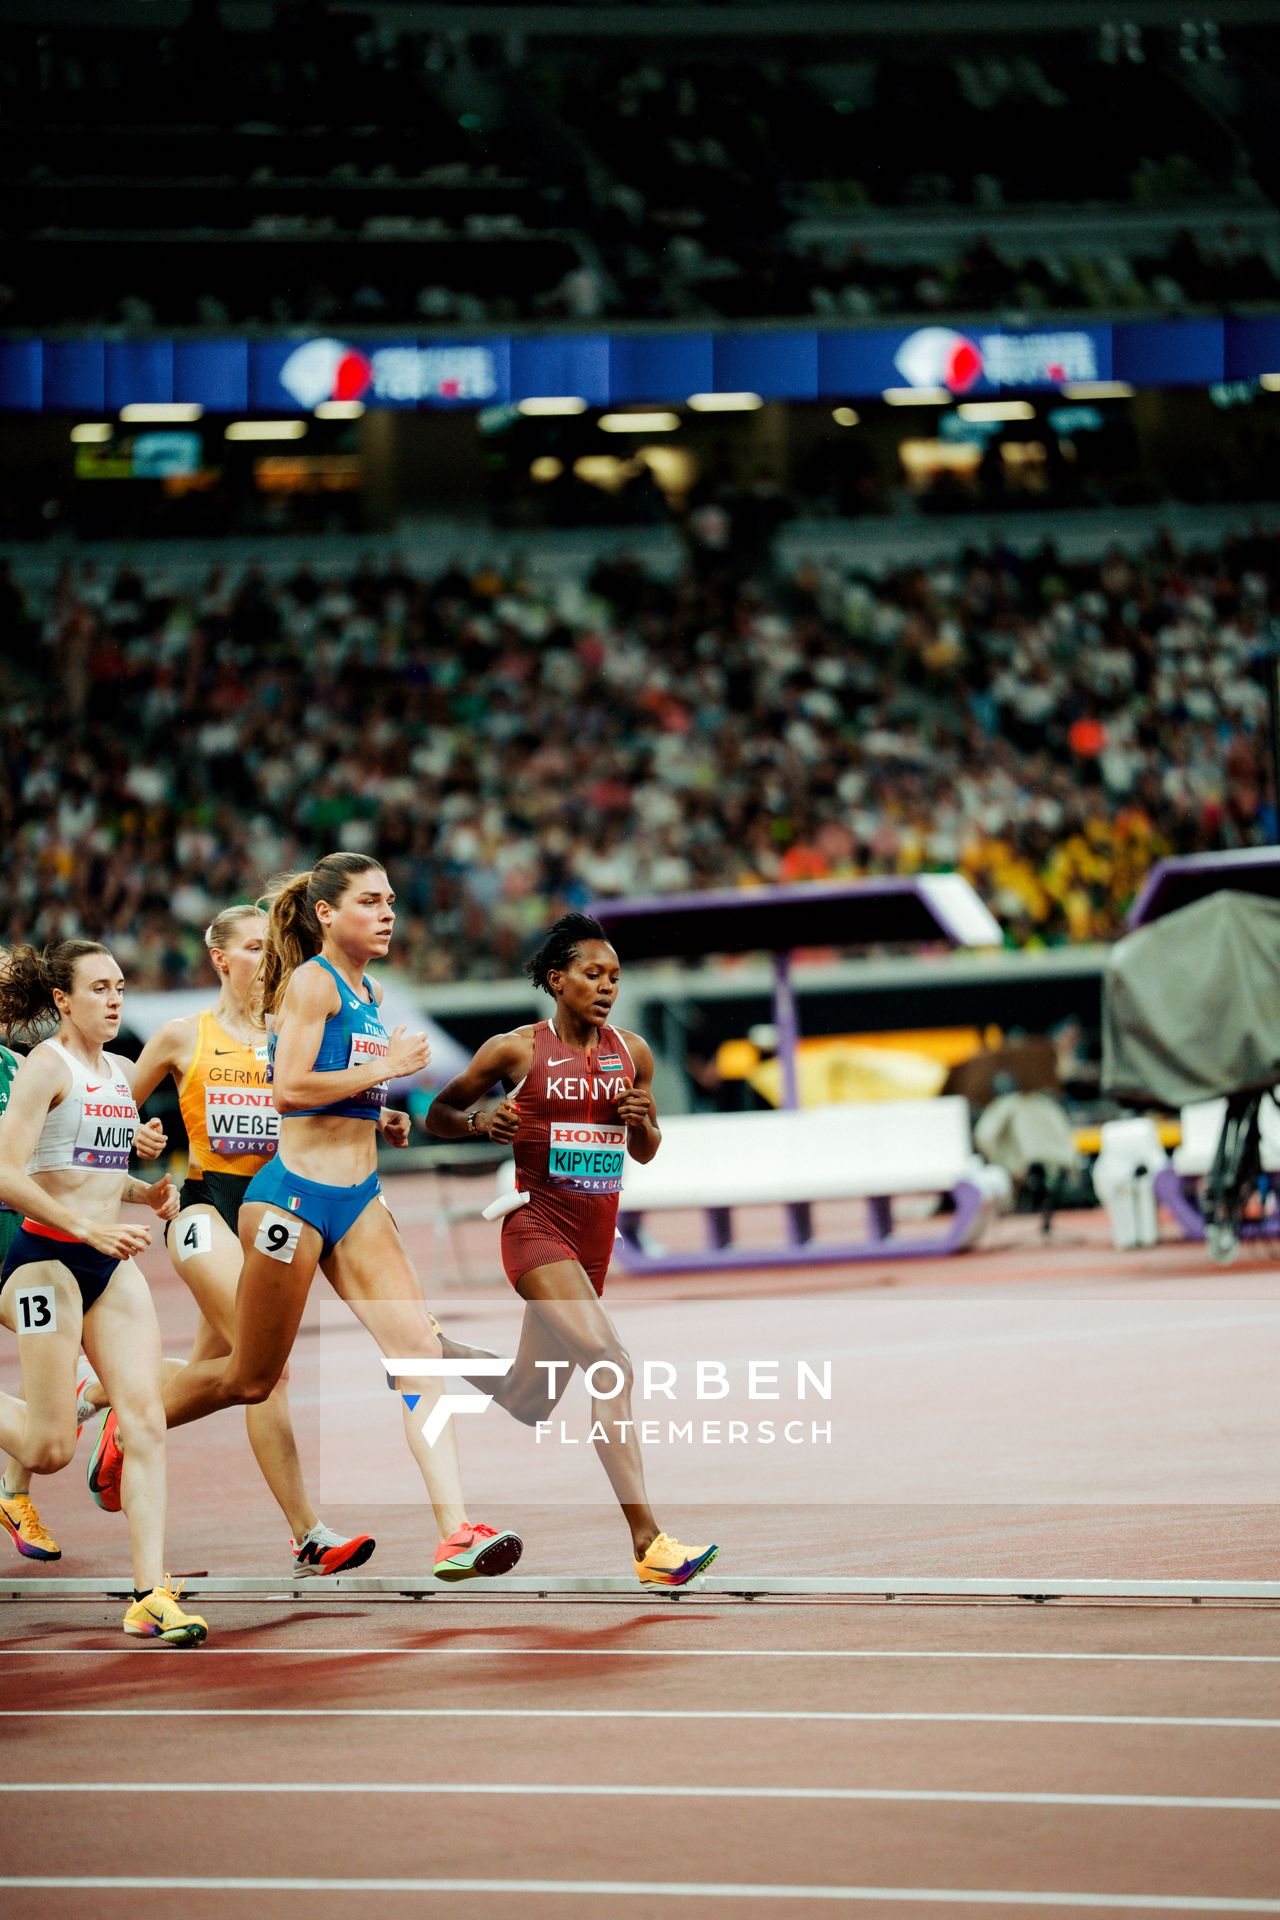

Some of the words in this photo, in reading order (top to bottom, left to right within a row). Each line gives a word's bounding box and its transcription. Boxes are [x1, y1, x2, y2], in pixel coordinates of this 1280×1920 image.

[94, 1126, 135, 1149] MUIR
[228, 1140, 275, 1152] TOKYO
[184, 1222, 202, 1249] 4
[265, 1224, 289, 1252] 9
[19, 1295, 52, 1328] 13
